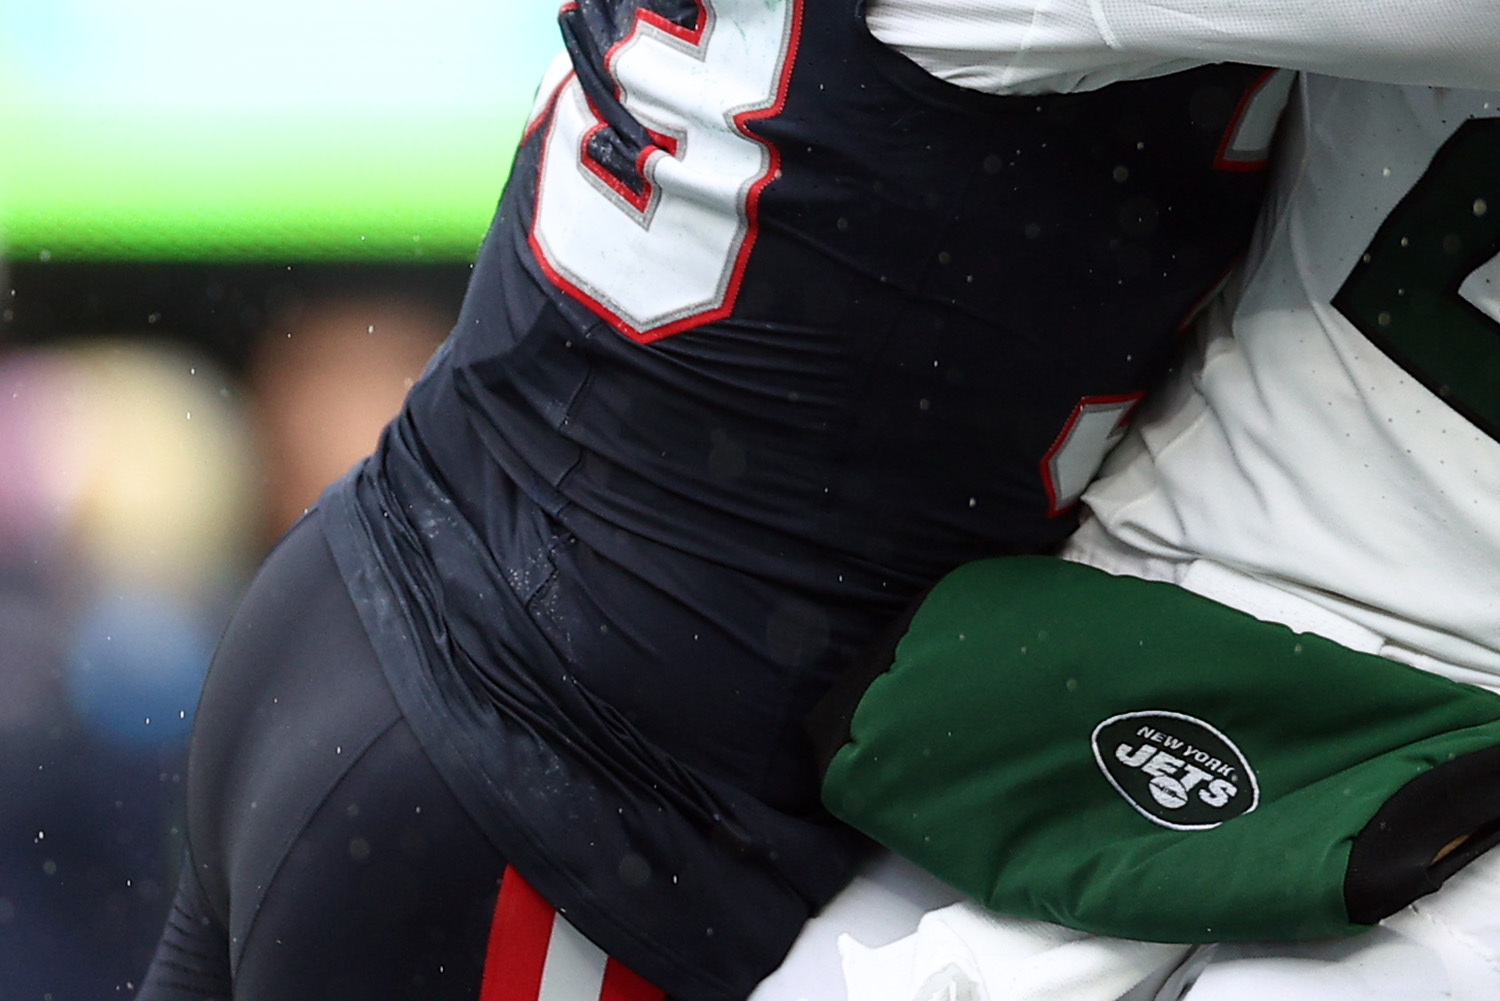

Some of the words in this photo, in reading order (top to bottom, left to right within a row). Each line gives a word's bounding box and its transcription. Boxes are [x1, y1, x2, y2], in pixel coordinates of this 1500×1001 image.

[1115, 743, 1238, 808] JETS
[1136, 725, 1184, 750] NEW
[1183, 745, 1236, 777] YORK
